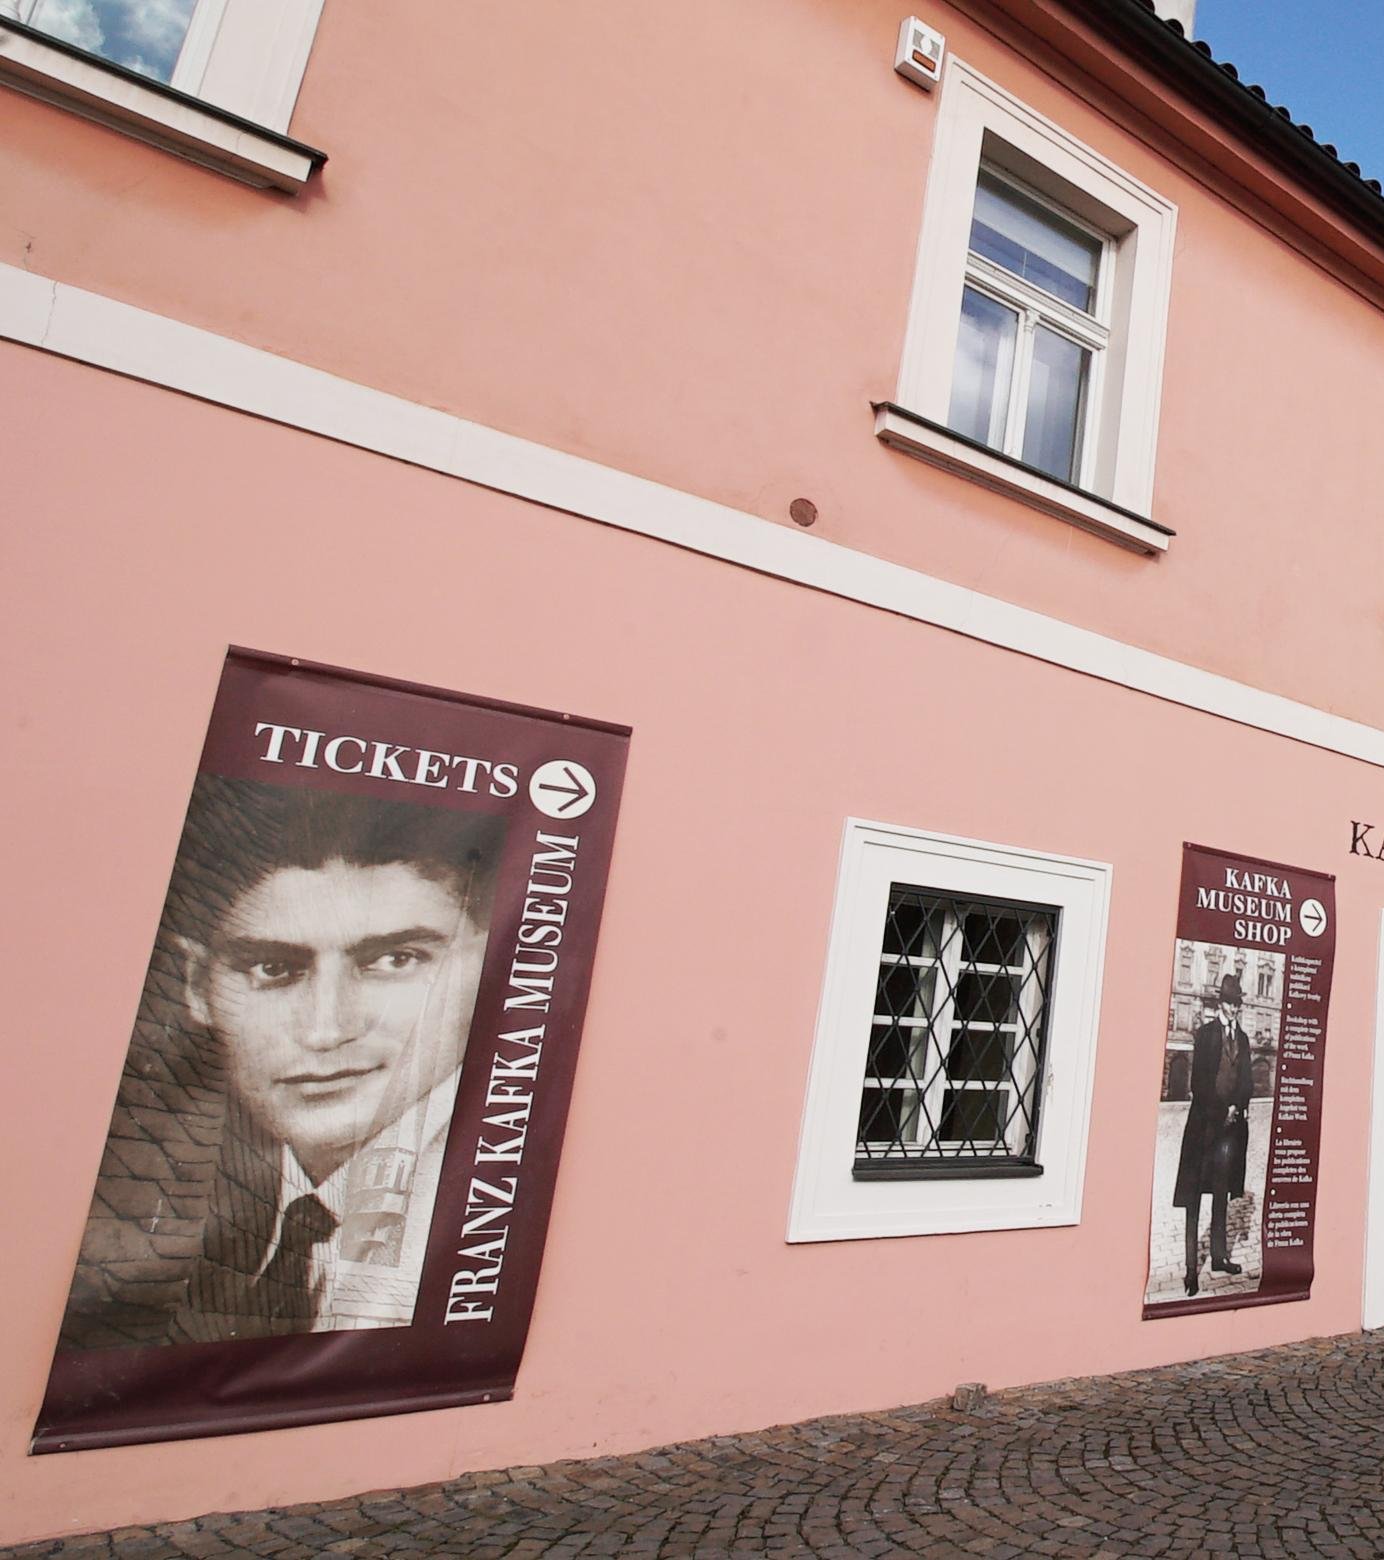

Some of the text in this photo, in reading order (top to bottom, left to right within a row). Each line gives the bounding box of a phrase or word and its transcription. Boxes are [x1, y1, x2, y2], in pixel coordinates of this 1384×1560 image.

[255, 722, 519, 798] TICKETS
[1225, 867, 1292, 899] KAFKA
[1196, 887, 1292, 923] MUSEUM
[1234, 919, 1292, 946] SHOP
[444, 830, 580, 1326] FRANZ KAFKA MUSEUM
